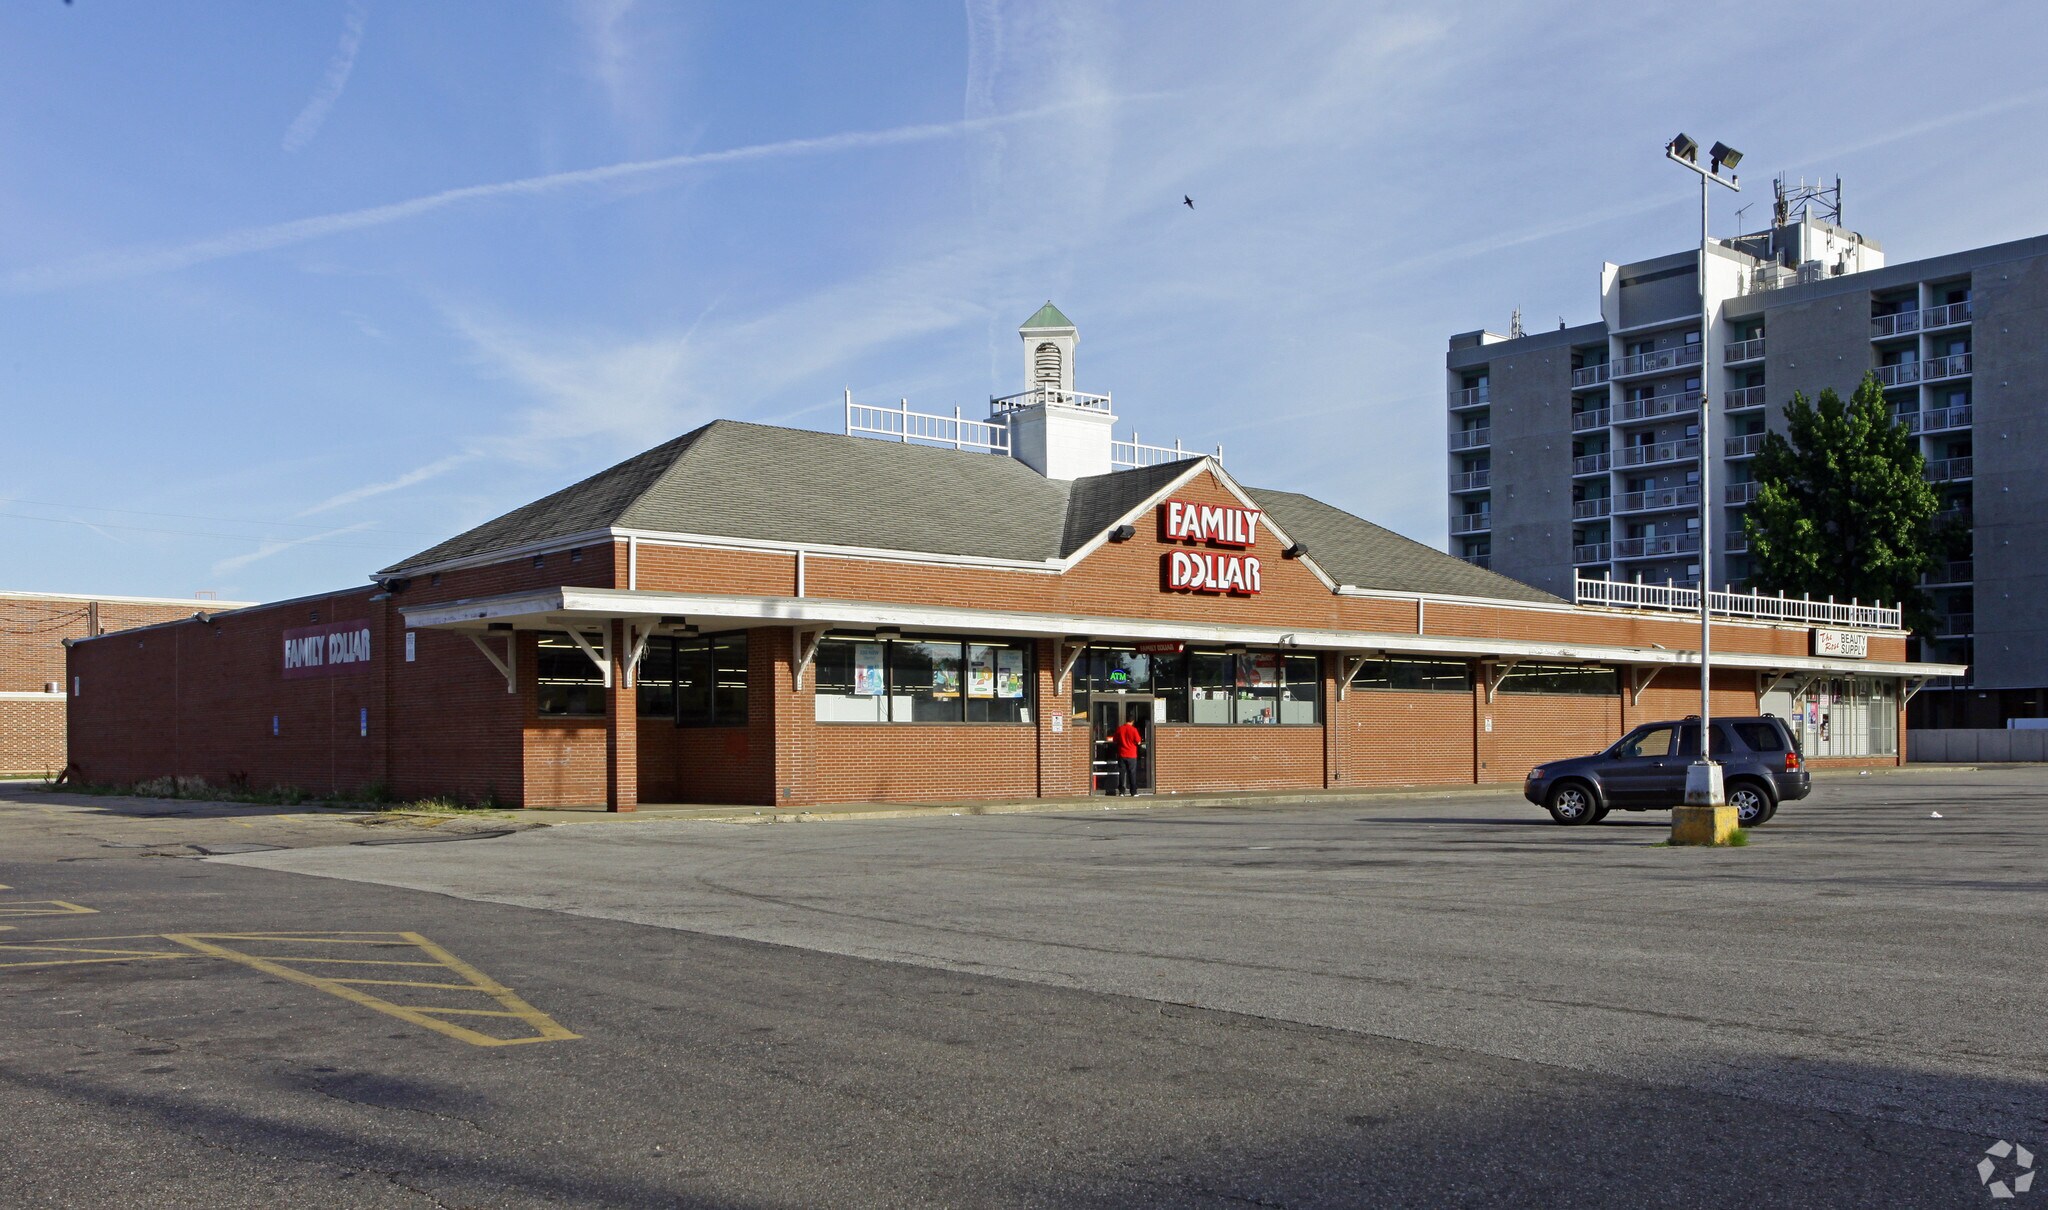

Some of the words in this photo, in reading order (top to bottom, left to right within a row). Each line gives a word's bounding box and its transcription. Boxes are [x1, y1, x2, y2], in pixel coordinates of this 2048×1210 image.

[1168, 501, 1261, 545] FAMILY
[1171, 551, 1261, 592] DOLLAR
[284, 635, 325, 669] FAMILY
[328, 628, 371, 665] DOLLAR
[1840, 633, 1866, 645] BEAUTY
[1840, 644, 1866, 655] SUPPLY
[1110, 672, 1127, 681] ATM
